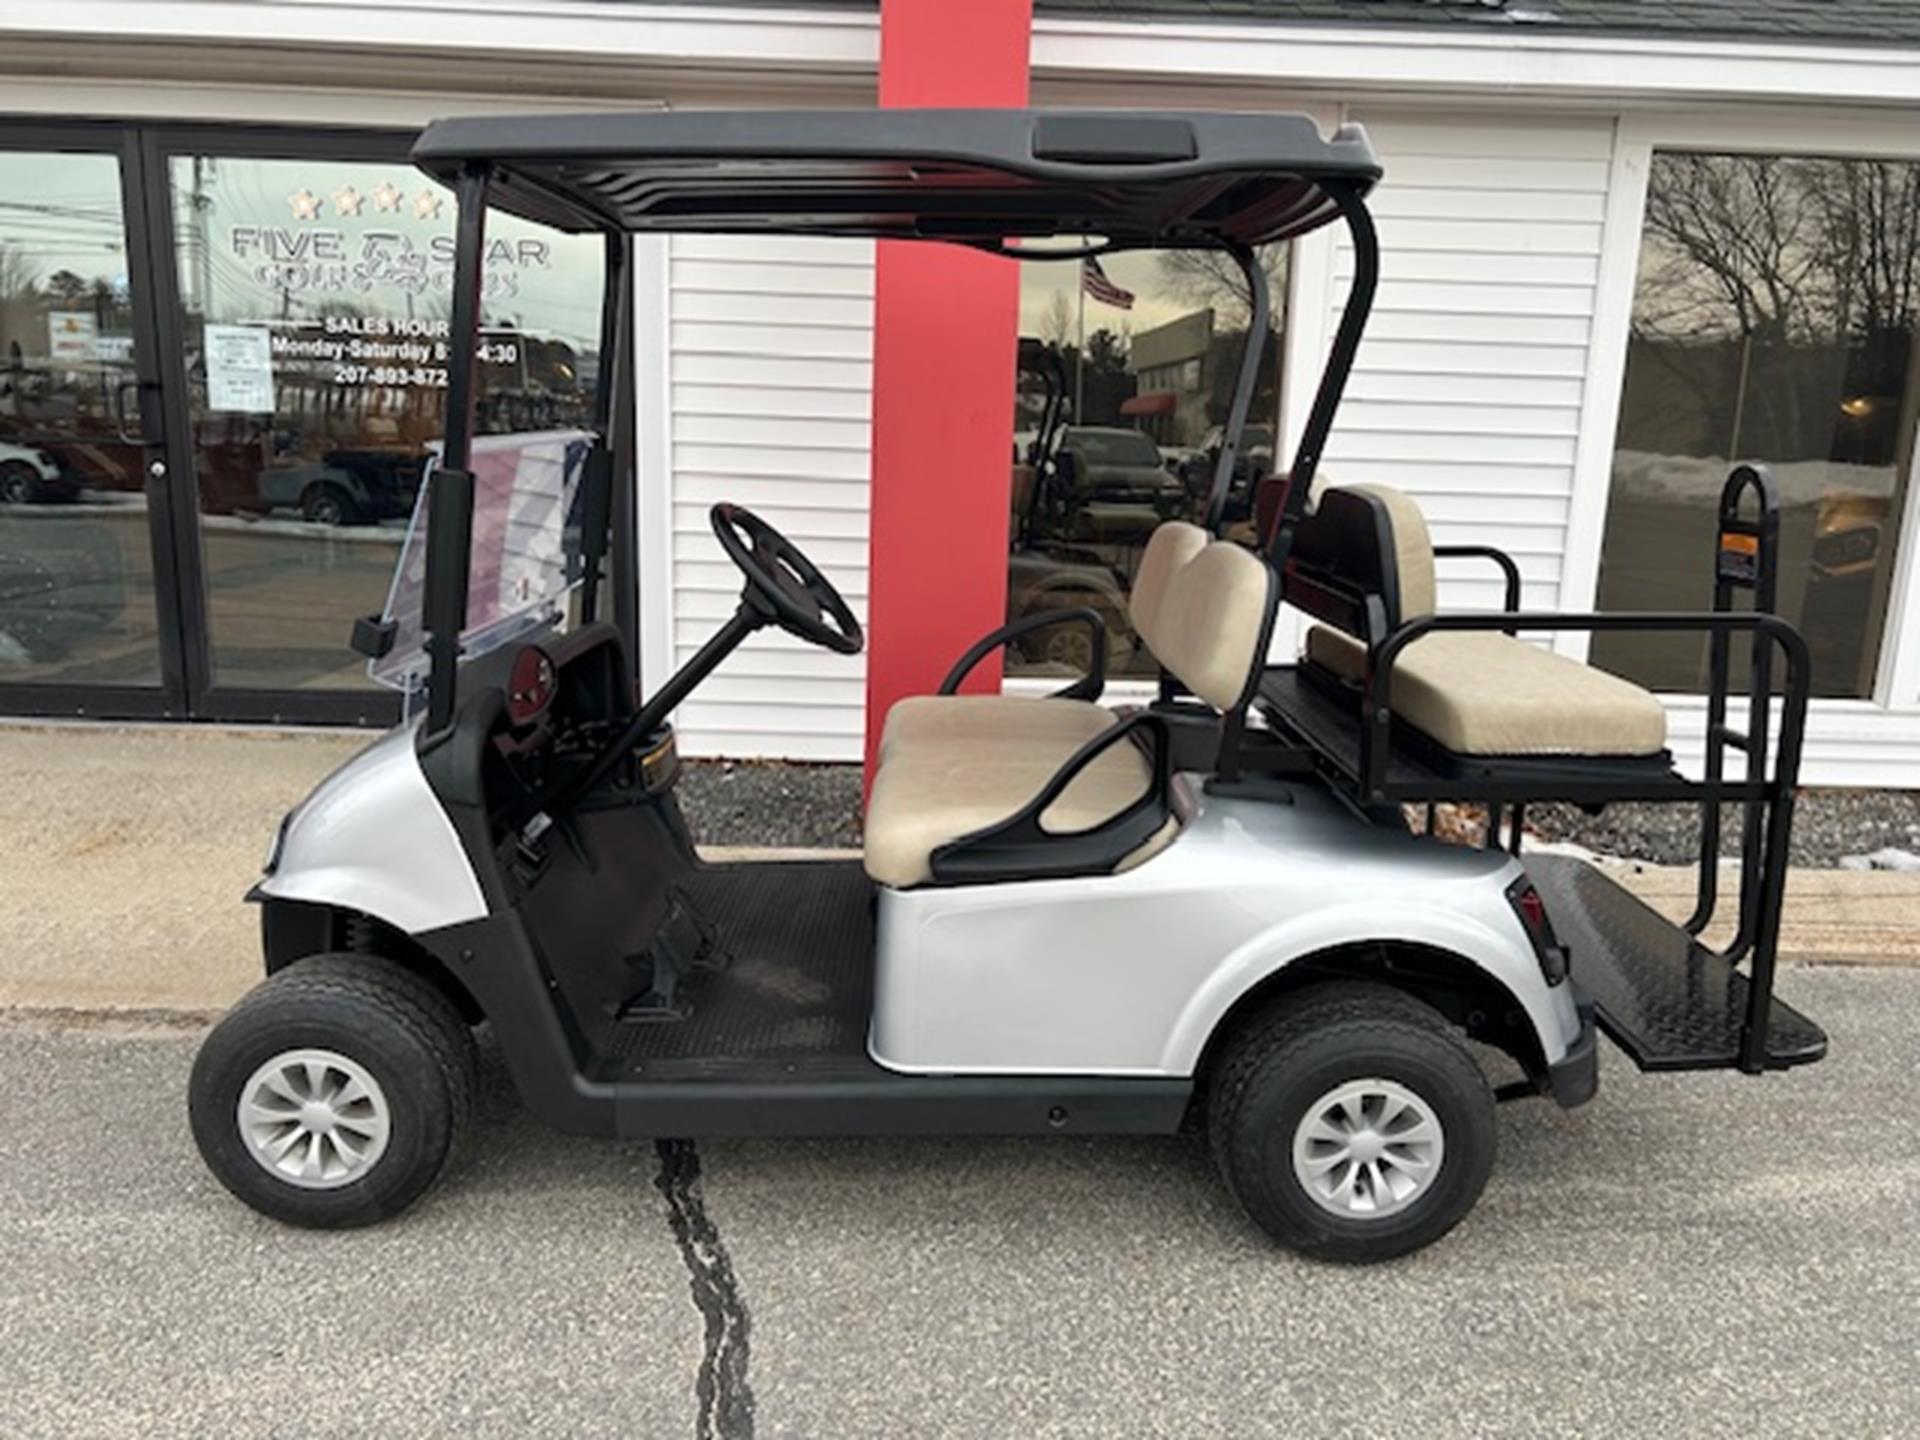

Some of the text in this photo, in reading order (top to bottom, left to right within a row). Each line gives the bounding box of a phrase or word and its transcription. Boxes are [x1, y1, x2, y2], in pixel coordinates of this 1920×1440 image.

[231, 227, 552, 267] FIVE SAR
[325, 317, 450, 337] SALES HOUR
[272, 336, 432, 363] Monday-Saturday
[335, 365, 450, 387] 207-893-872
